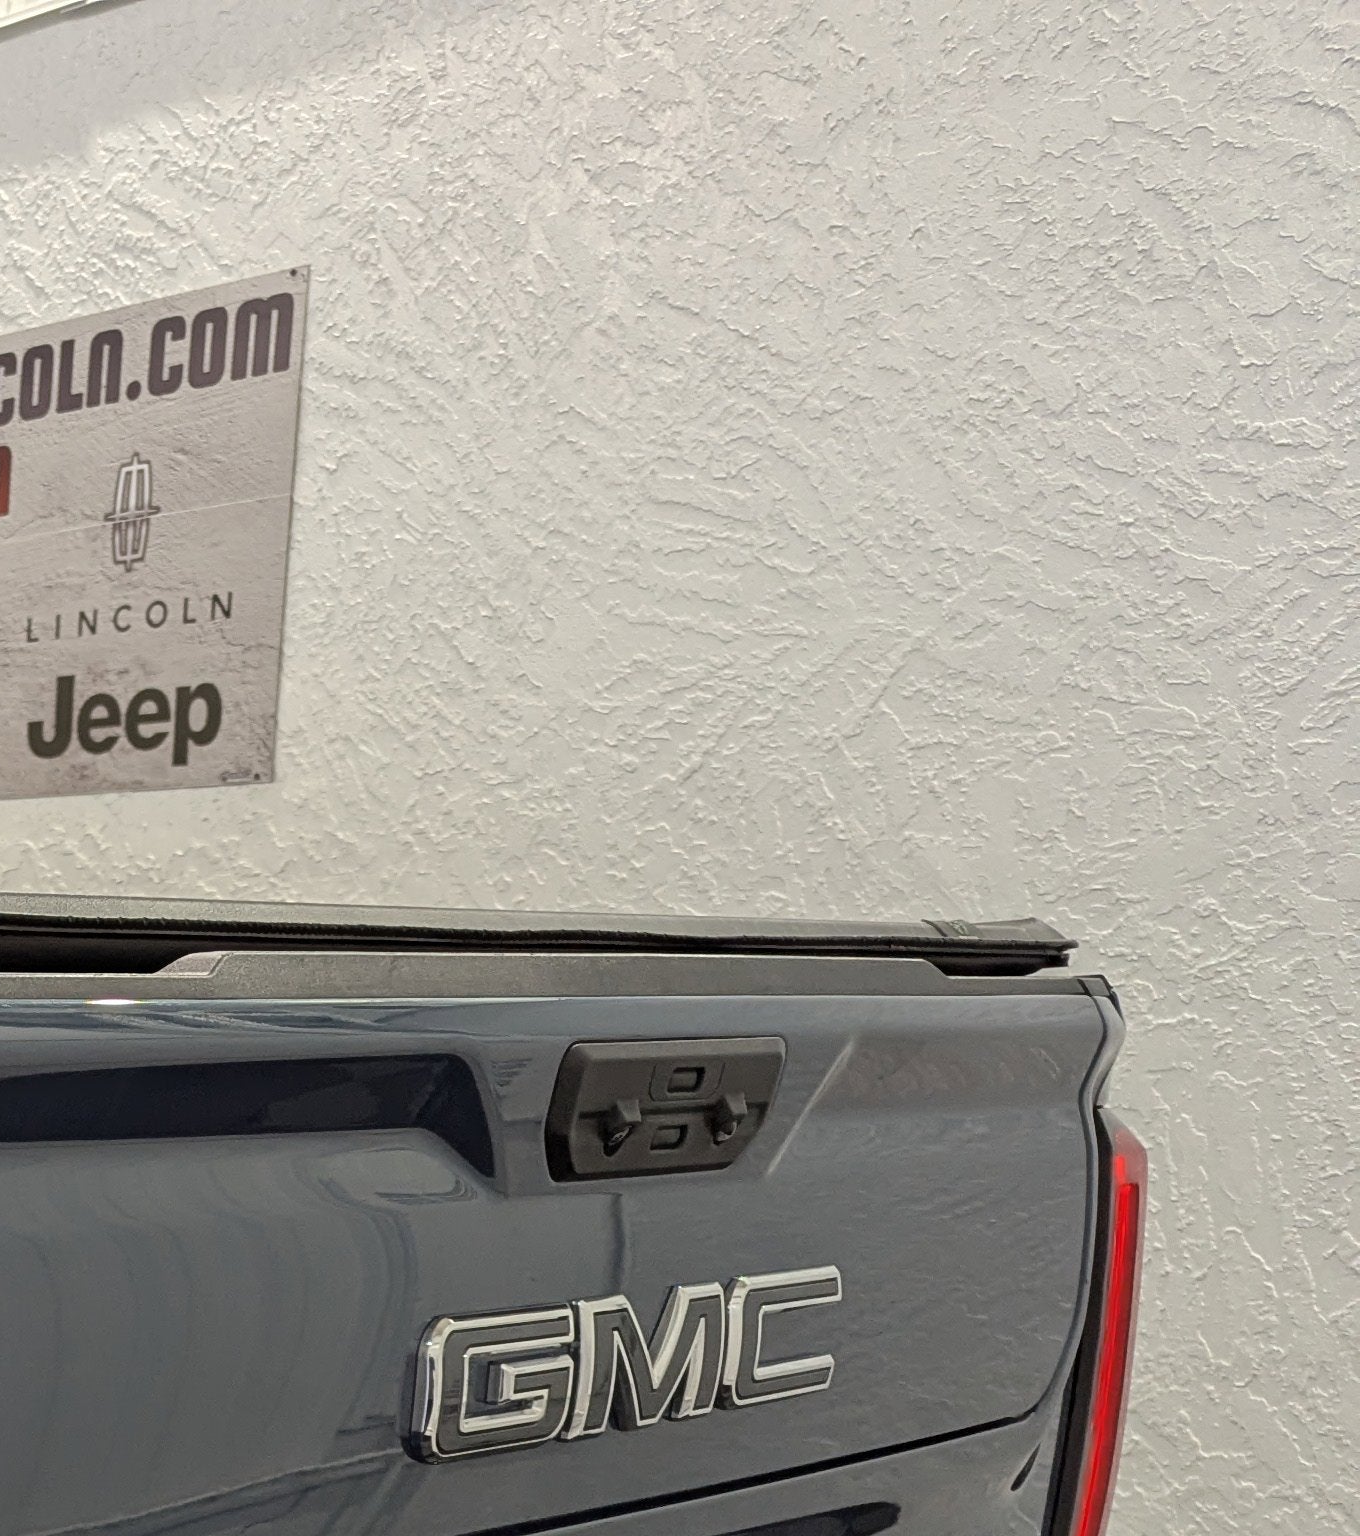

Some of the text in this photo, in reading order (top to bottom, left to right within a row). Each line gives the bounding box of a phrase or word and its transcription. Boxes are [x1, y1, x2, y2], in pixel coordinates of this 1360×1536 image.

[26, 591, 233, 643] LINCOLN
[27, 675, 223, 767] Jeep
[402, 1265, 843, 1465] GMC
